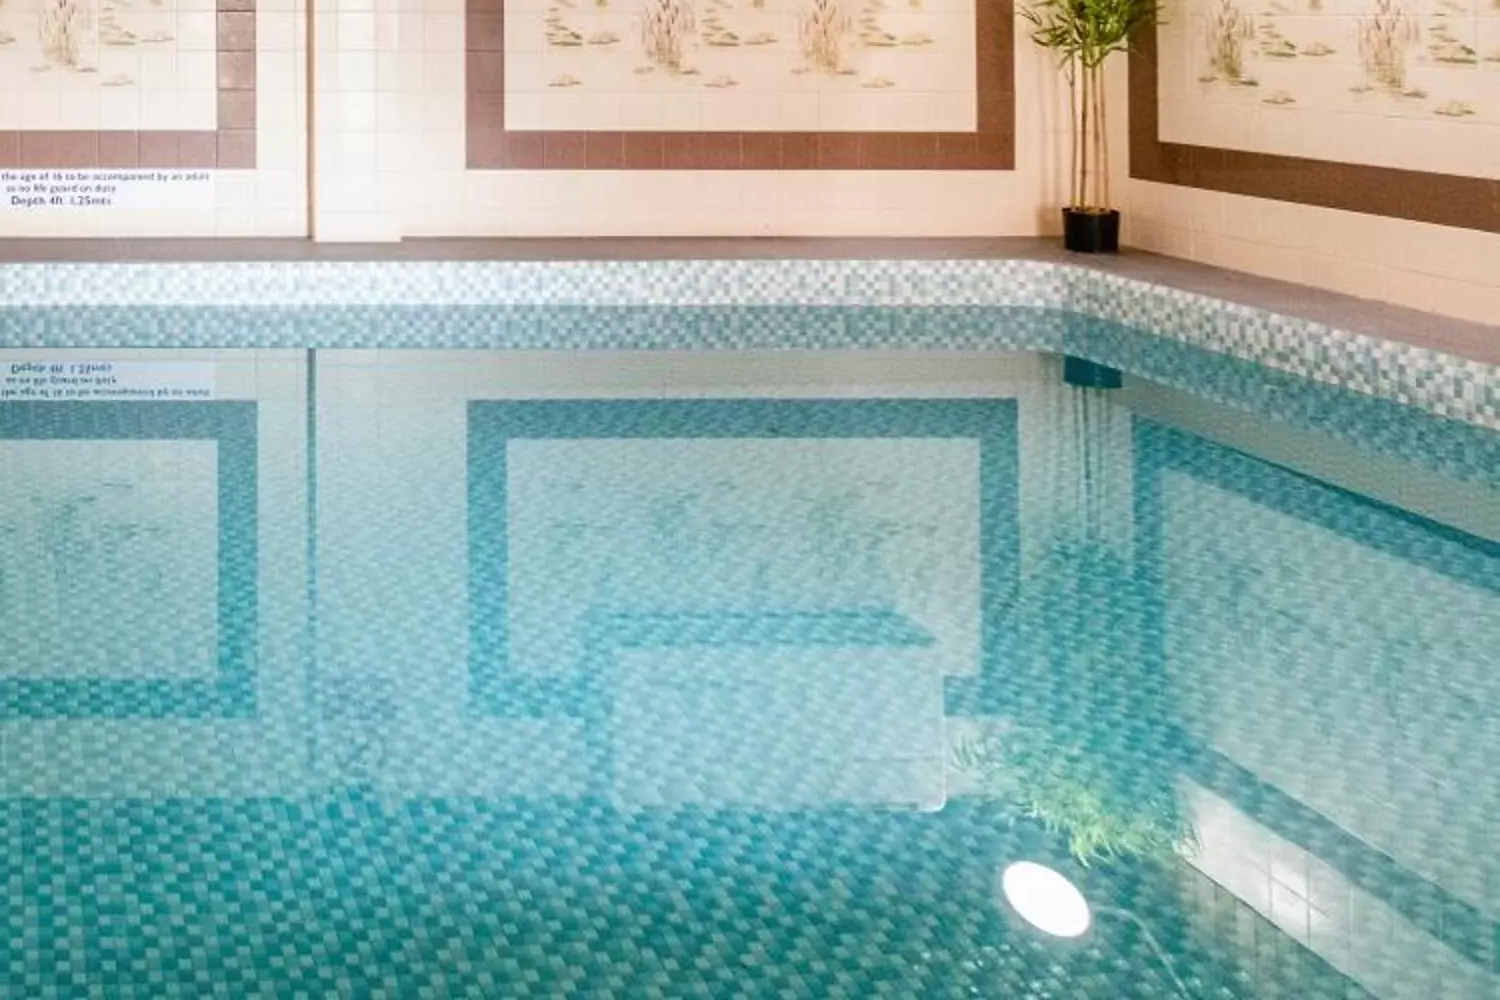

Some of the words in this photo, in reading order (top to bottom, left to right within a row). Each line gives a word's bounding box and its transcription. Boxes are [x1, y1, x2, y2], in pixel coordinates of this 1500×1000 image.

[1, 172, 17, 181] the
[19, 174, 36, 183] age
[39, 172, 50, 181] of
[53, 172, 63, 181] 16
[65, 172, 76, 181] to
[77, 172, 90, 181] be
[92, 172, 155, 183] accompanied
[157, 172, 168, 183] by
[186, 172, 210, 181] adult
[18, 185, 31, 193] no
[33, 183, 47, 193] life
[49, 183, 77, 195] guard
[79, 185, 93, 193] on
[94, 183, 116, 195] duty
[10, 195, 46, 207] Depth
[49, 195, 63, 206] 4ft
